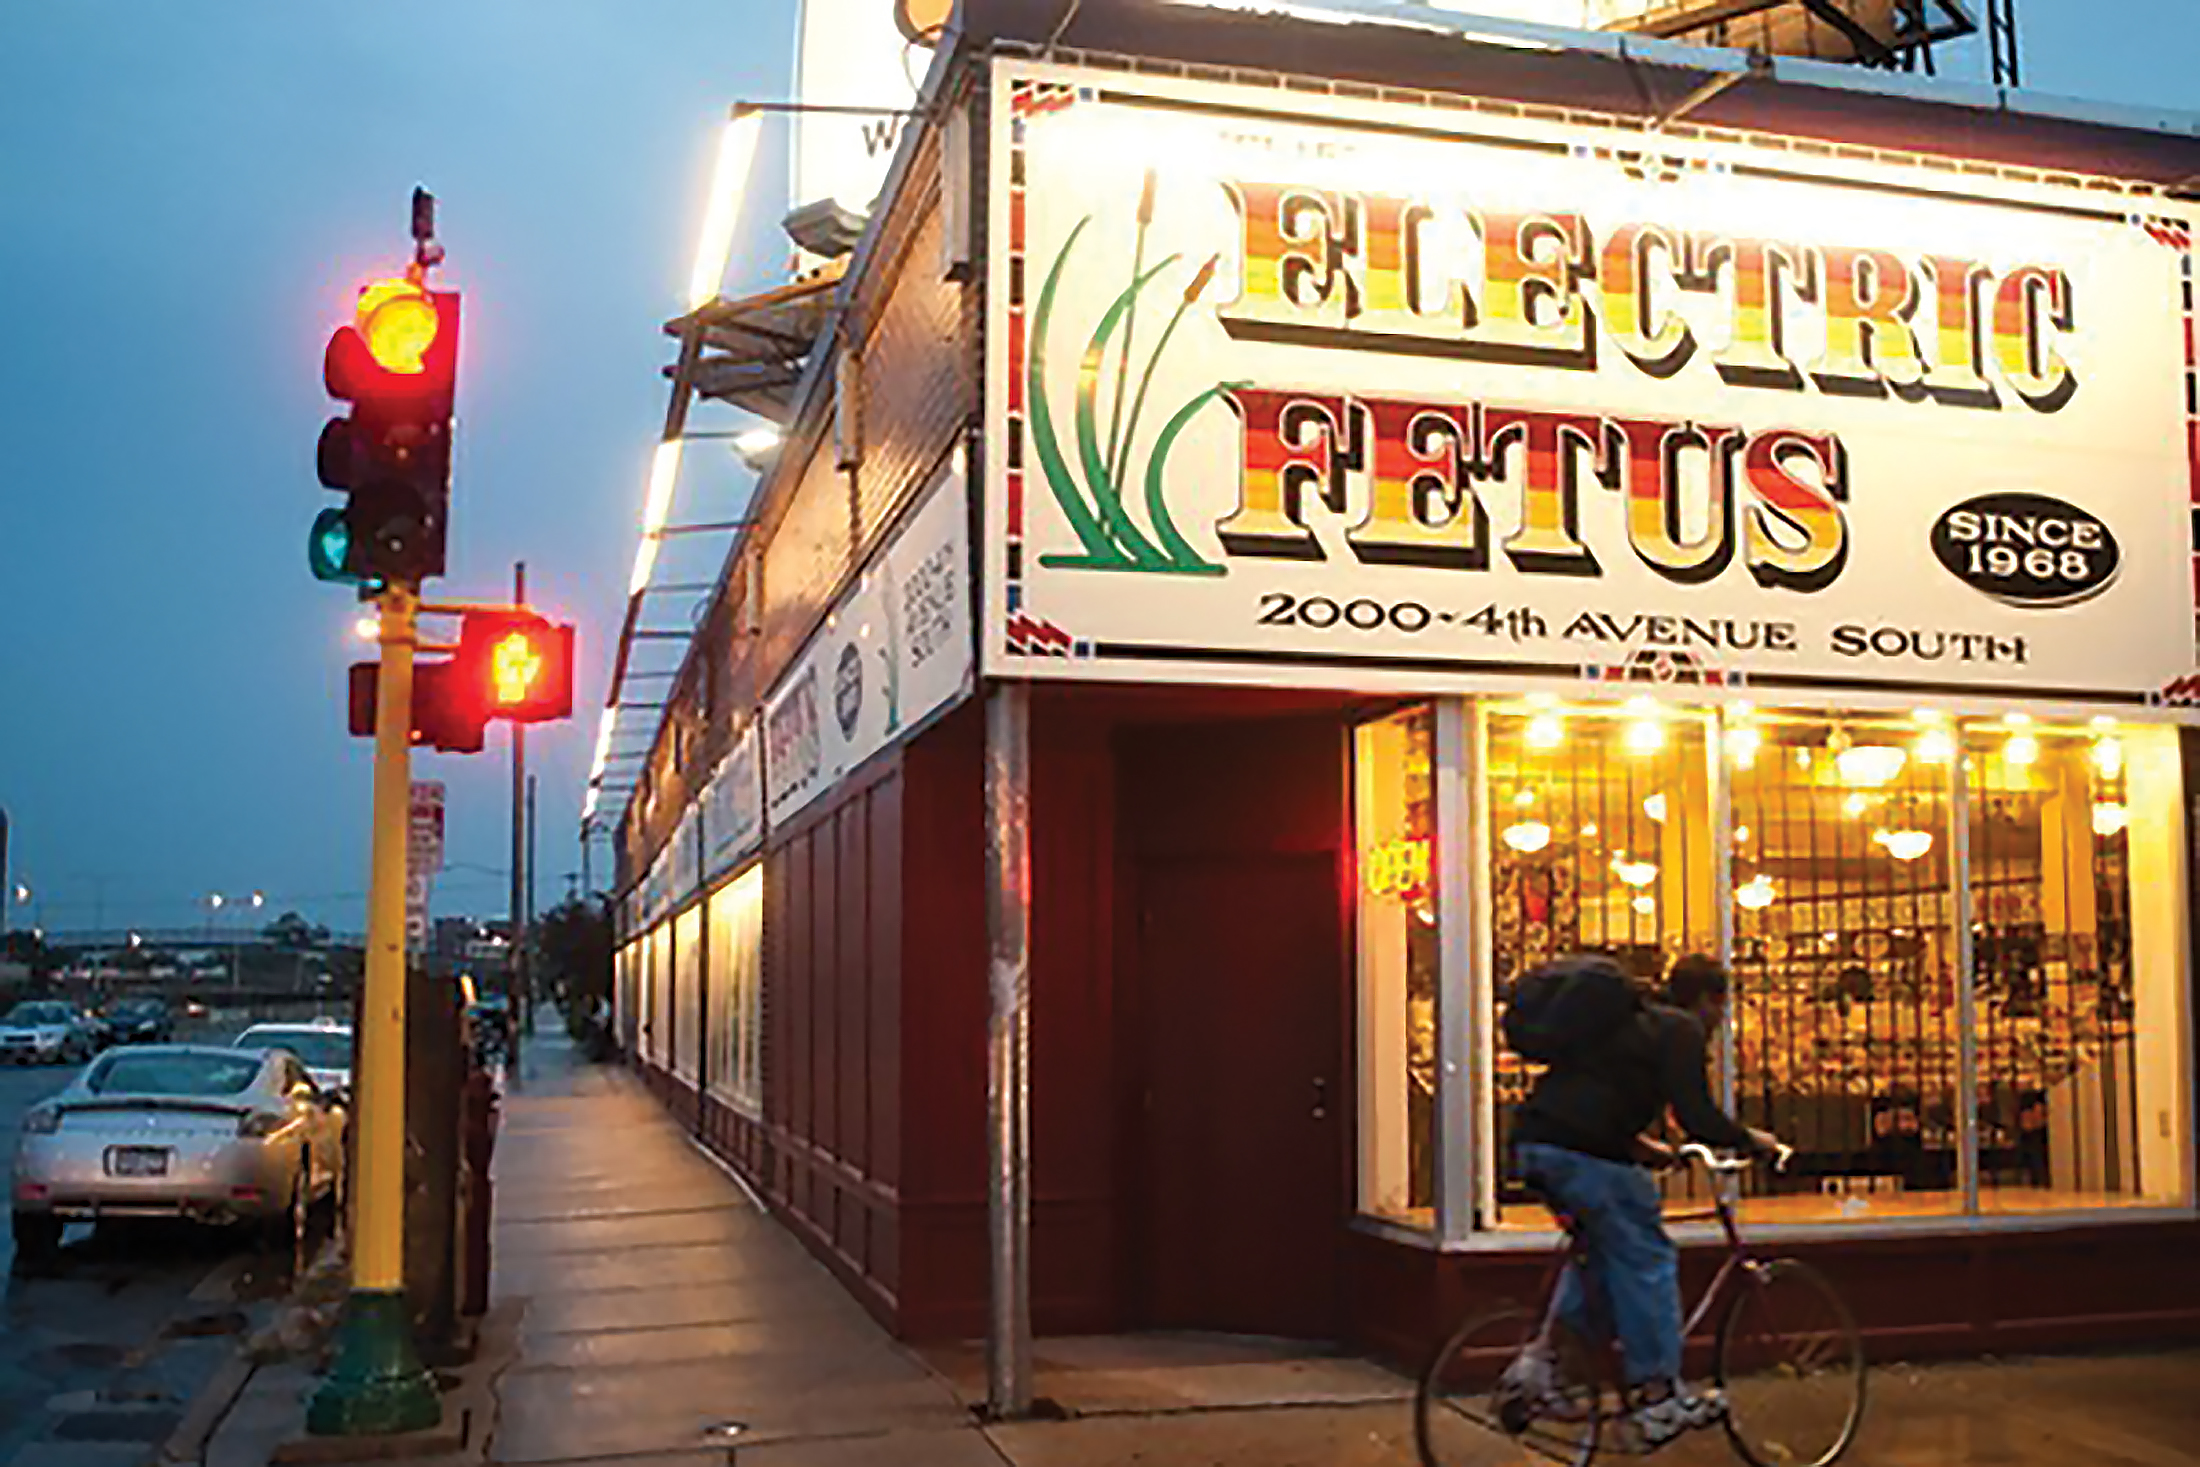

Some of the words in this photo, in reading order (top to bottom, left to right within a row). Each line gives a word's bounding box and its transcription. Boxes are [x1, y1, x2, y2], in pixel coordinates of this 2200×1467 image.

[1216, 179, 2078, 413] ELECTRIC
[1216, 386, 1850, 593] FETUS
[1947, 511, 2103, 549] SINCE
[1967, 545, 2090, 581] 1968
[1562, 611, 1798, 652] AVENUE
[1830, 624, 2028, 665] SOUTH
